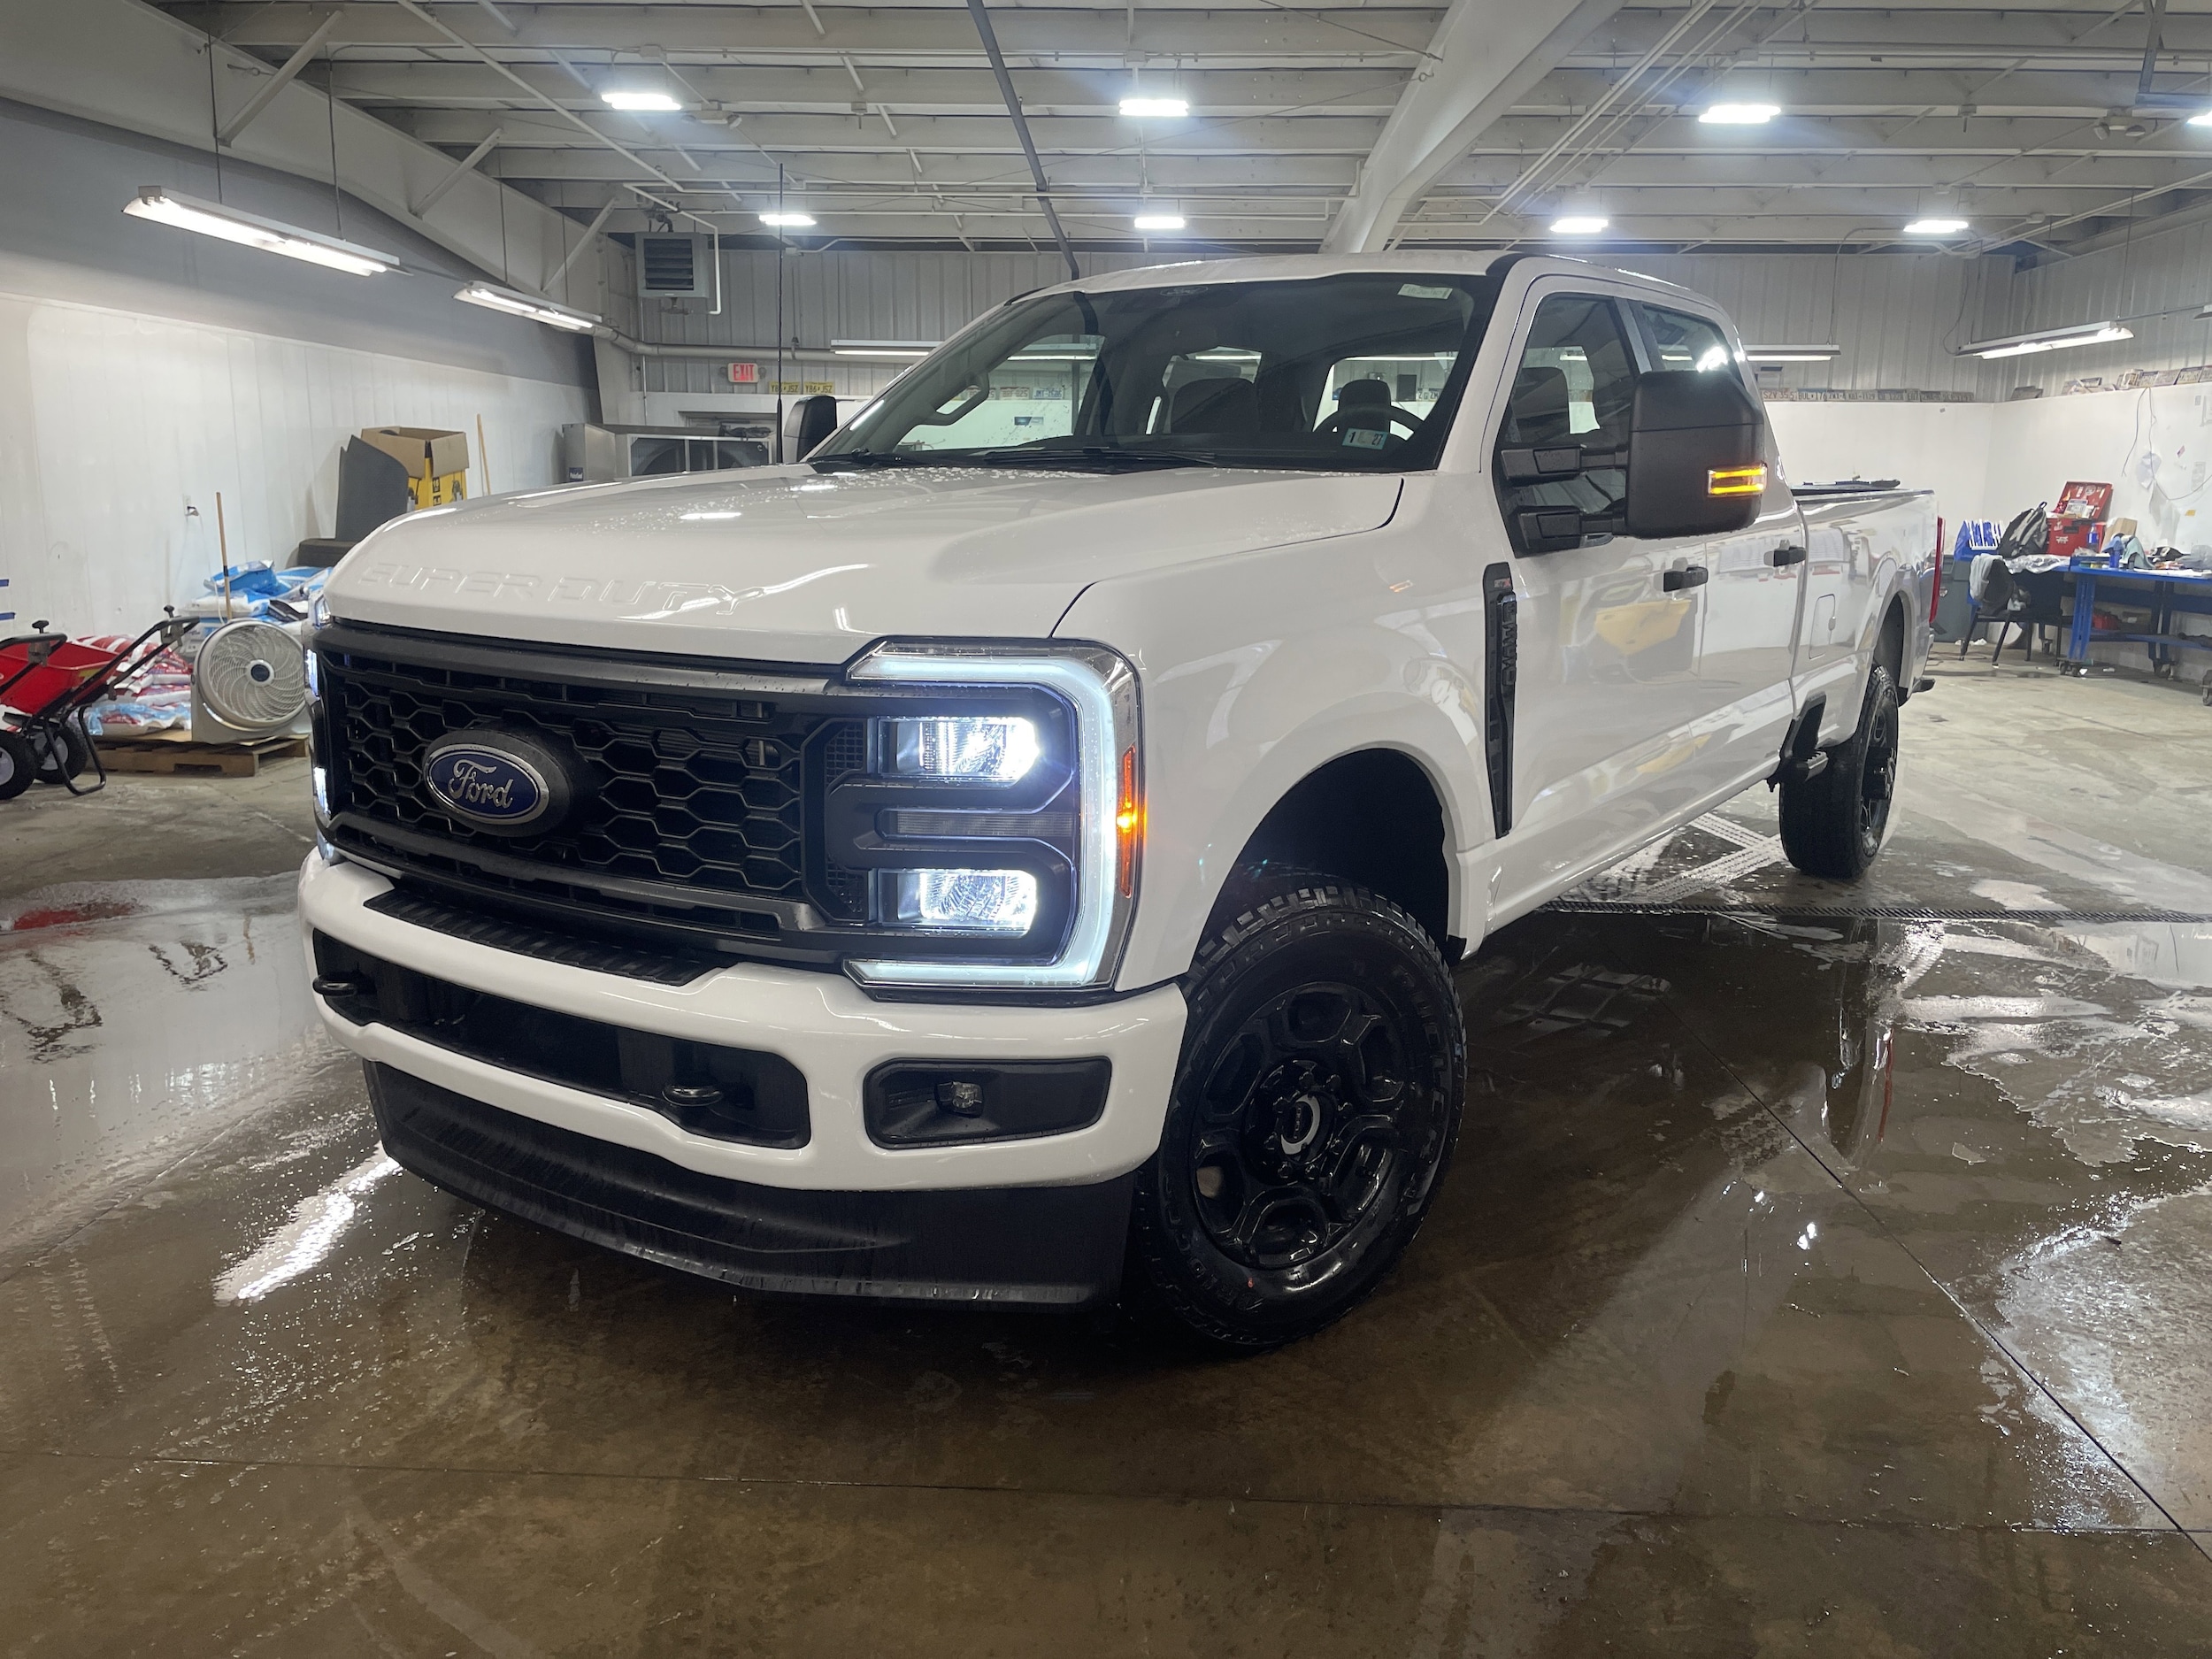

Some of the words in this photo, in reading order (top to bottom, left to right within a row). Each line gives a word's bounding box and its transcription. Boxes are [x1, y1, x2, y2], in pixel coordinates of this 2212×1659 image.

[733, 364, 754, 380] EXIT
[357, 562, 543, 599] SUPER
[547, 577, 765, 615] DUTY
[448, 759, 513, 809] Ford
